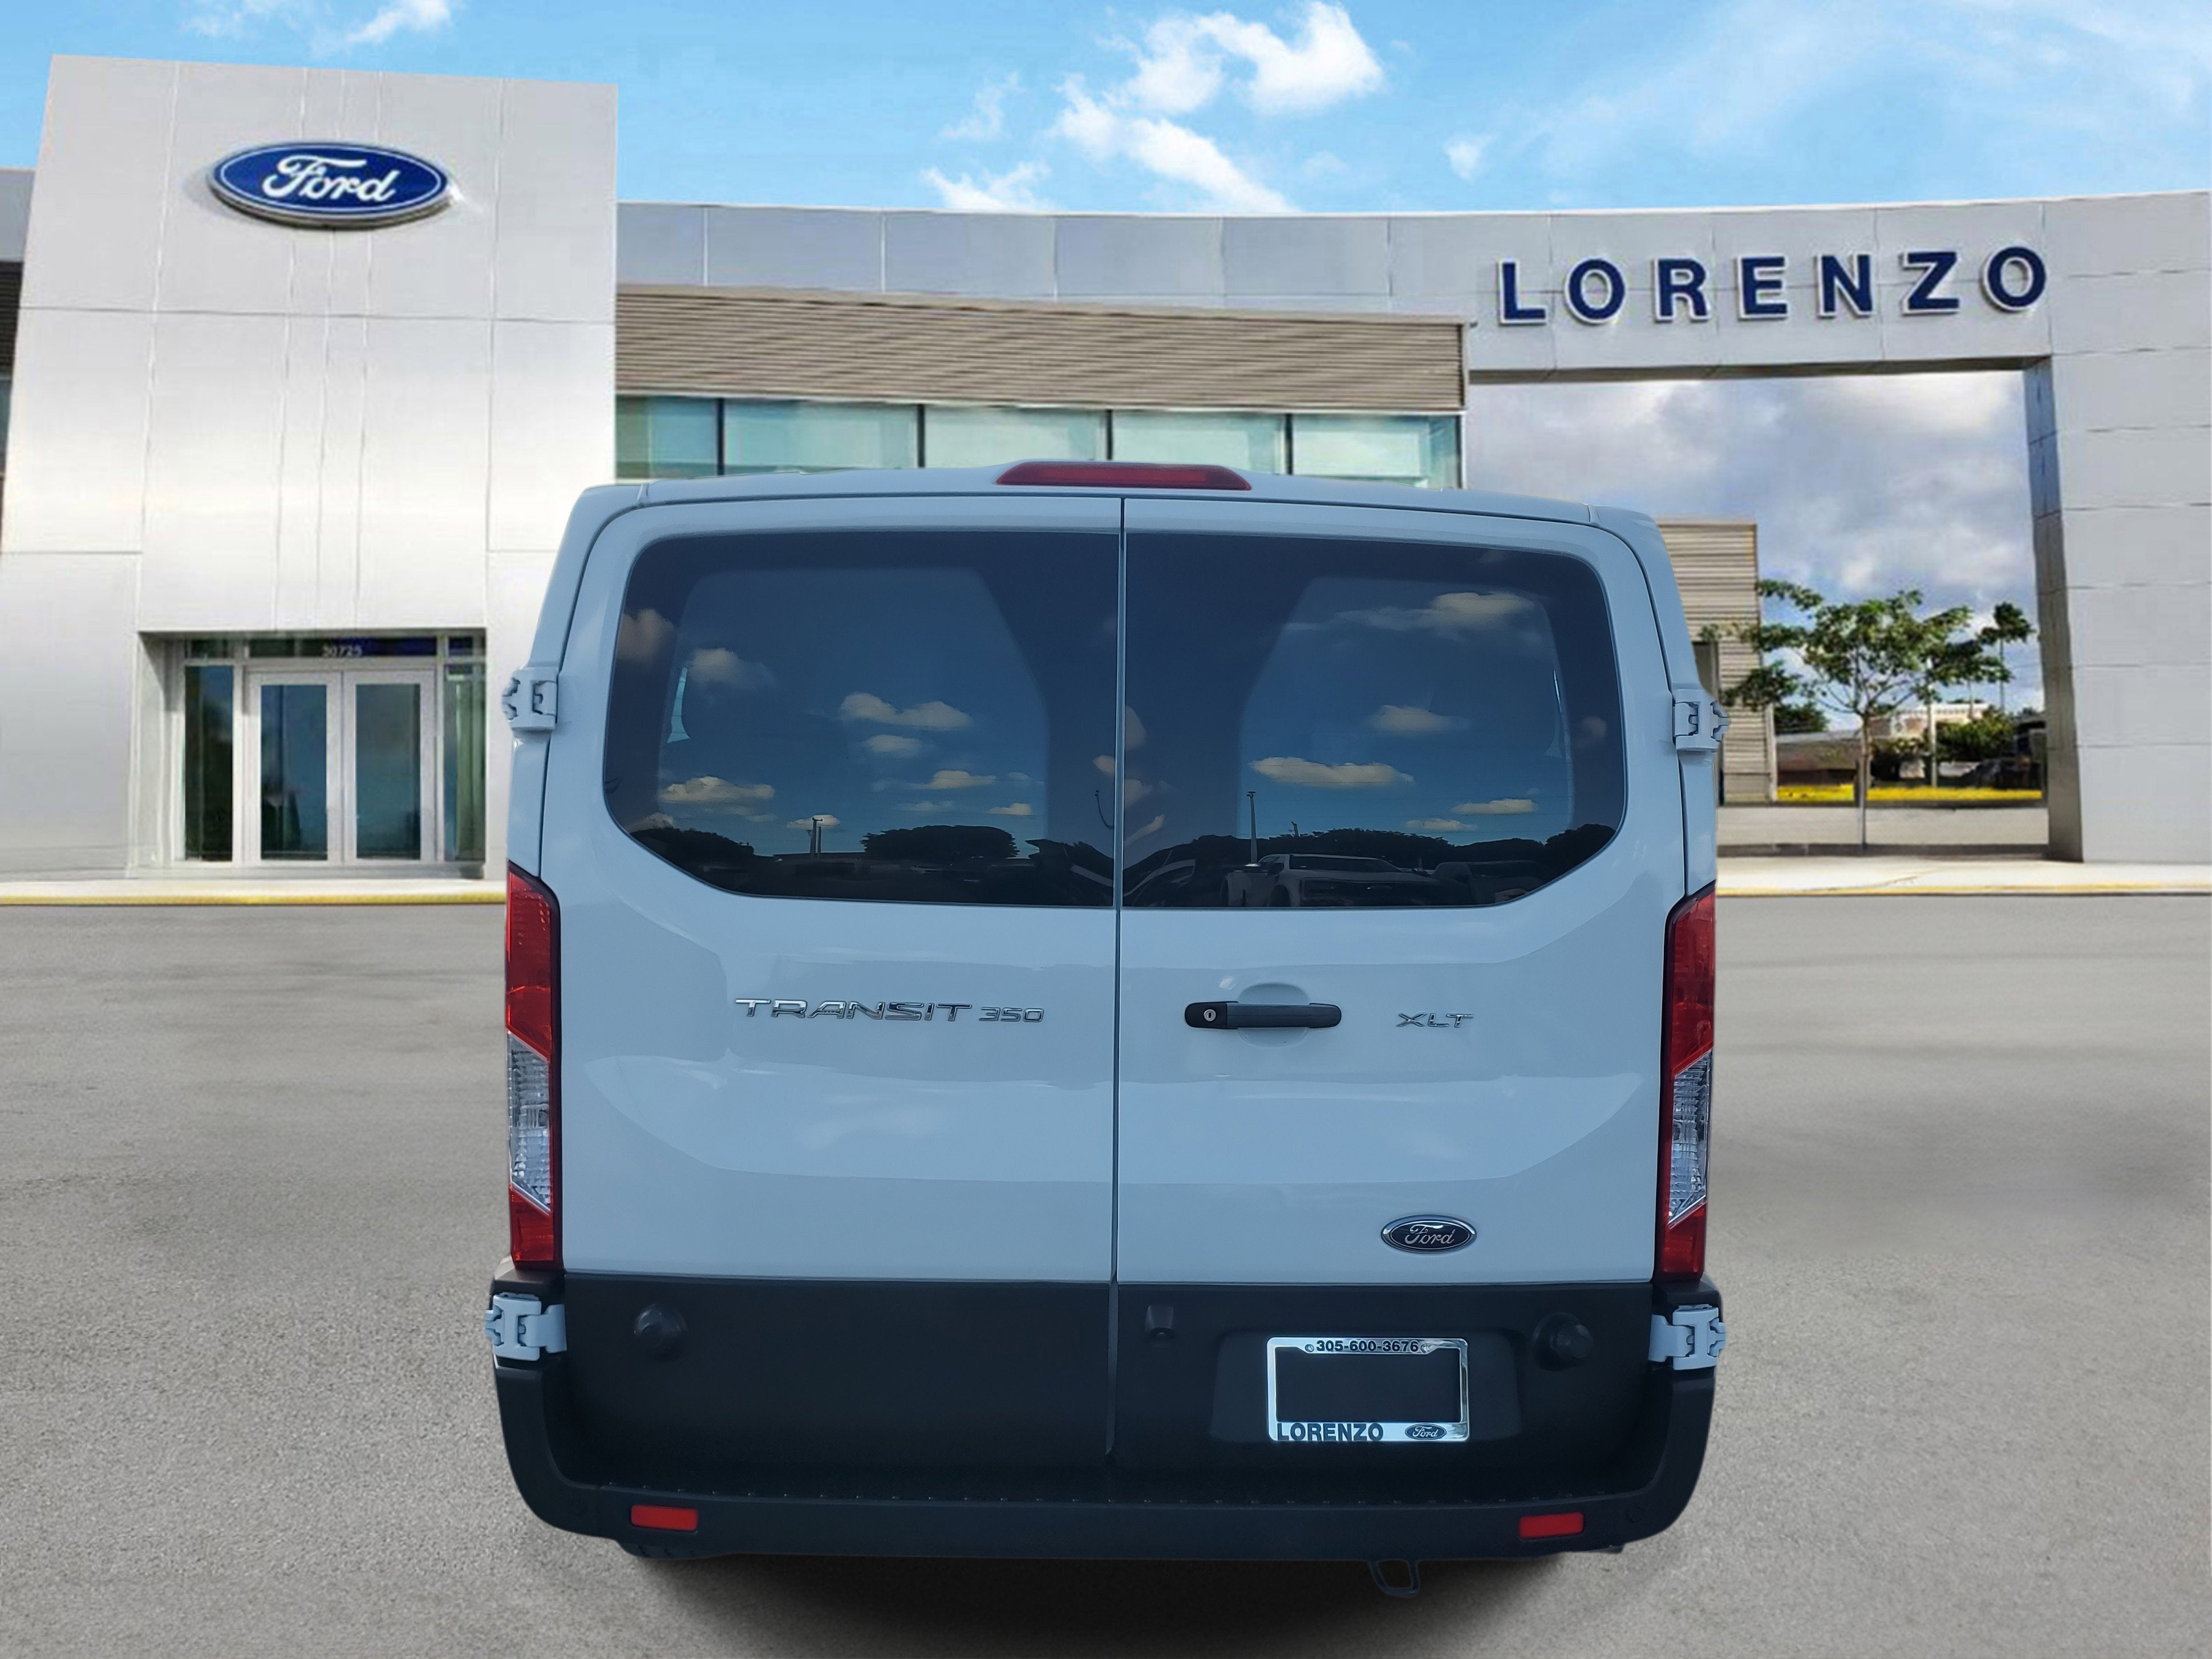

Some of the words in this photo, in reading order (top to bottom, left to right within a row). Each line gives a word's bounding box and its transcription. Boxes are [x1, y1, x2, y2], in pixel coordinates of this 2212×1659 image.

[262, 155, 401, 201] Ford
[1499, 246, 2047, 325] LORENZO
[735, 998, 972, 1022] TRANSIT
[979, 1006, 1044, 1022] 350
[1396, 1013, 1474, 1028] XLT
[1404, 1224, 1456, 1244] Ford
[1316, 1340, 1419, 1352] 305-600-3676
[1277, 1422, 1384, 1441] LORENZO
[1412, 1425, 1439, 1438] Ford
